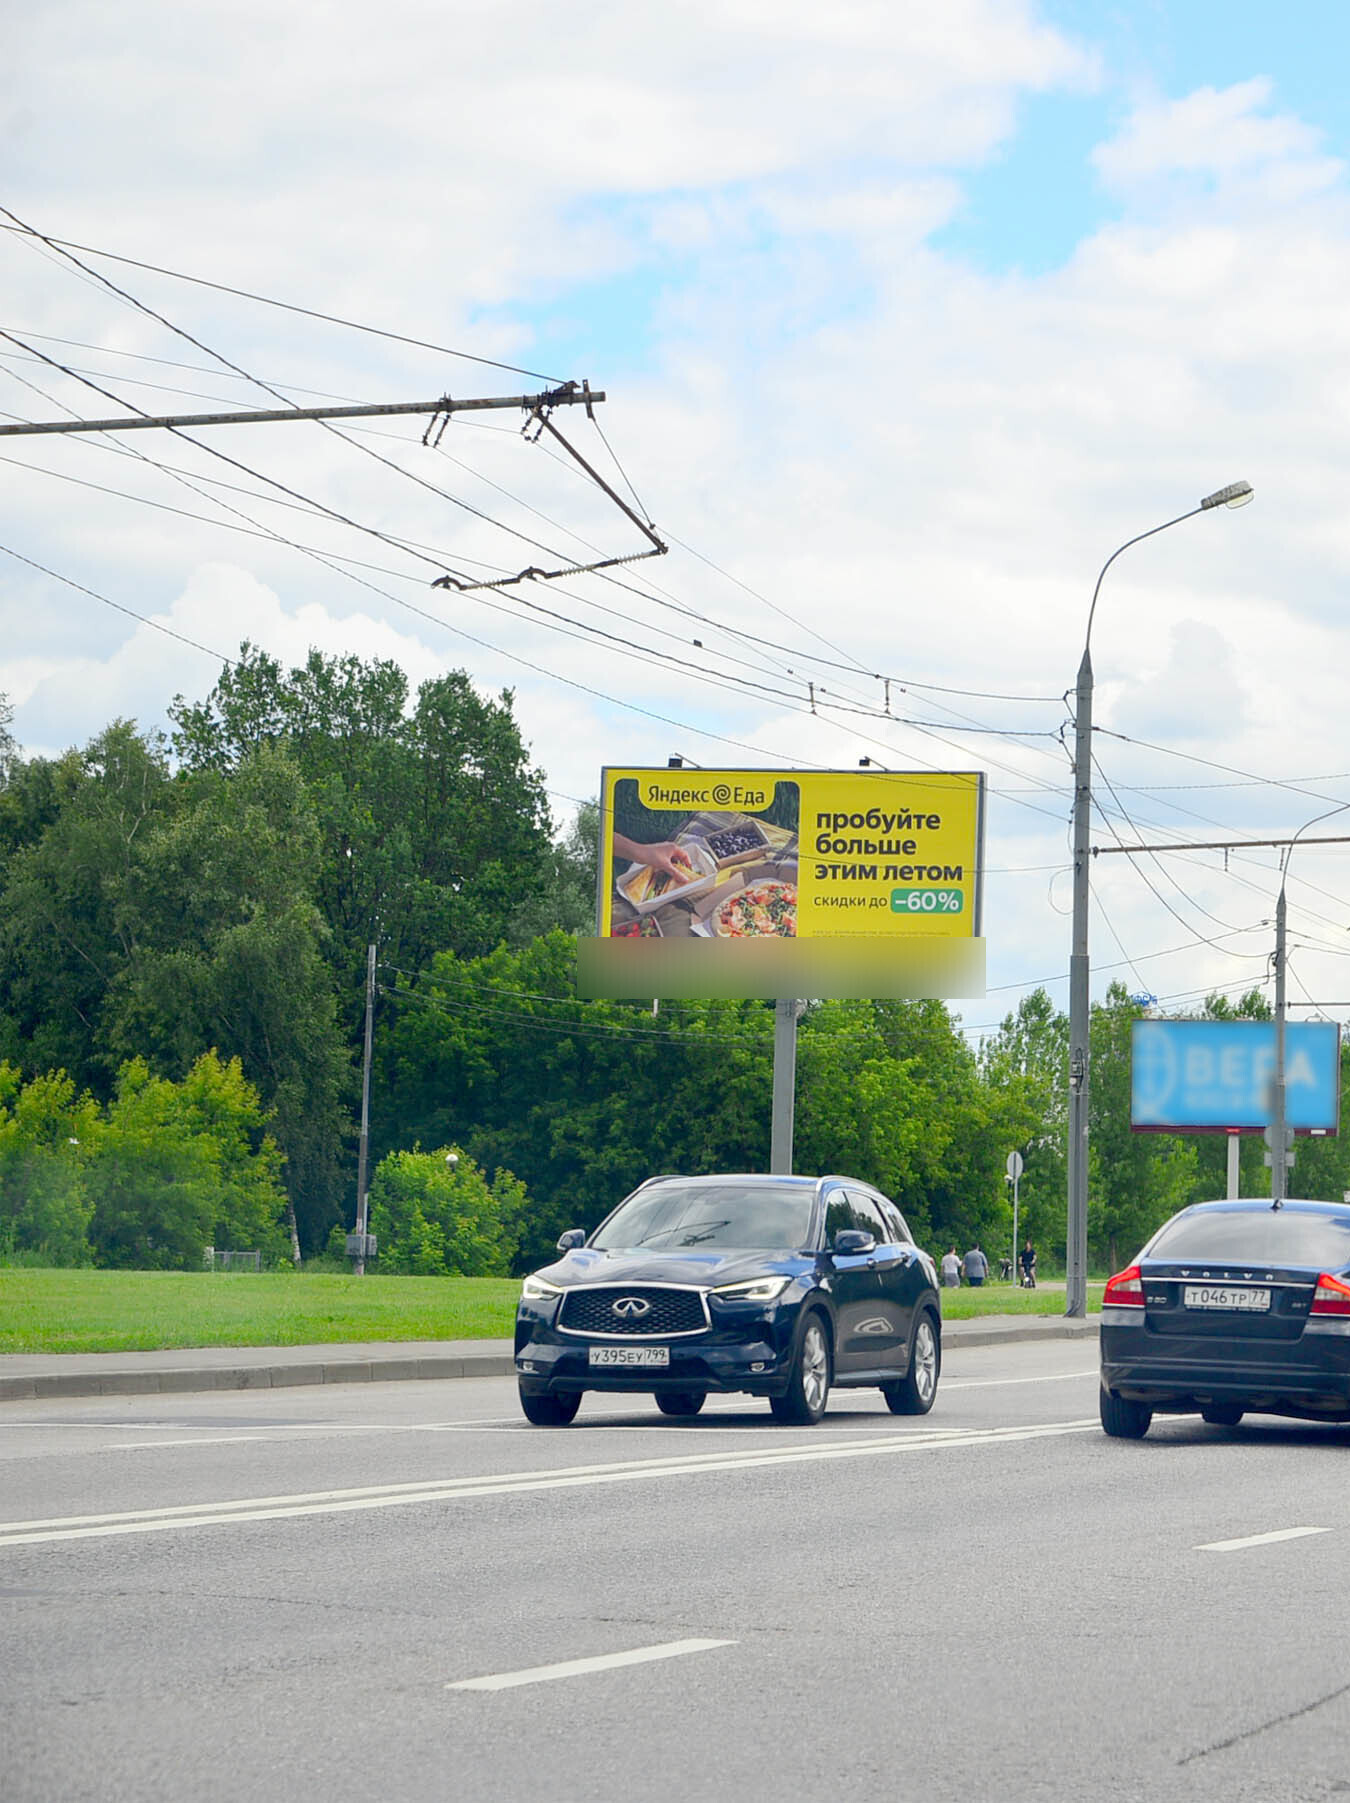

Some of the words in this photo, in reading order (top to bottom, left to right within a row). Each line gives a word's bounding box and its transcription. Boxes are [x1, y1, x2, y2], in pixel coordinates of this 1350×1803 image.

[648, 785, 710, 804] Яндекс
[733, 786, 765, 806] Еда
[816, 808, 941, 834] пробуйте
[815, 833, 917, 855] больше
[814, 864, 878, 881] этим
[883, 865, 963, 881] летом
[814, 896, 866, 909] скидки
[869, 897, 888, 909] до
[1181, 1270, 1274, 1281] VOLVO
